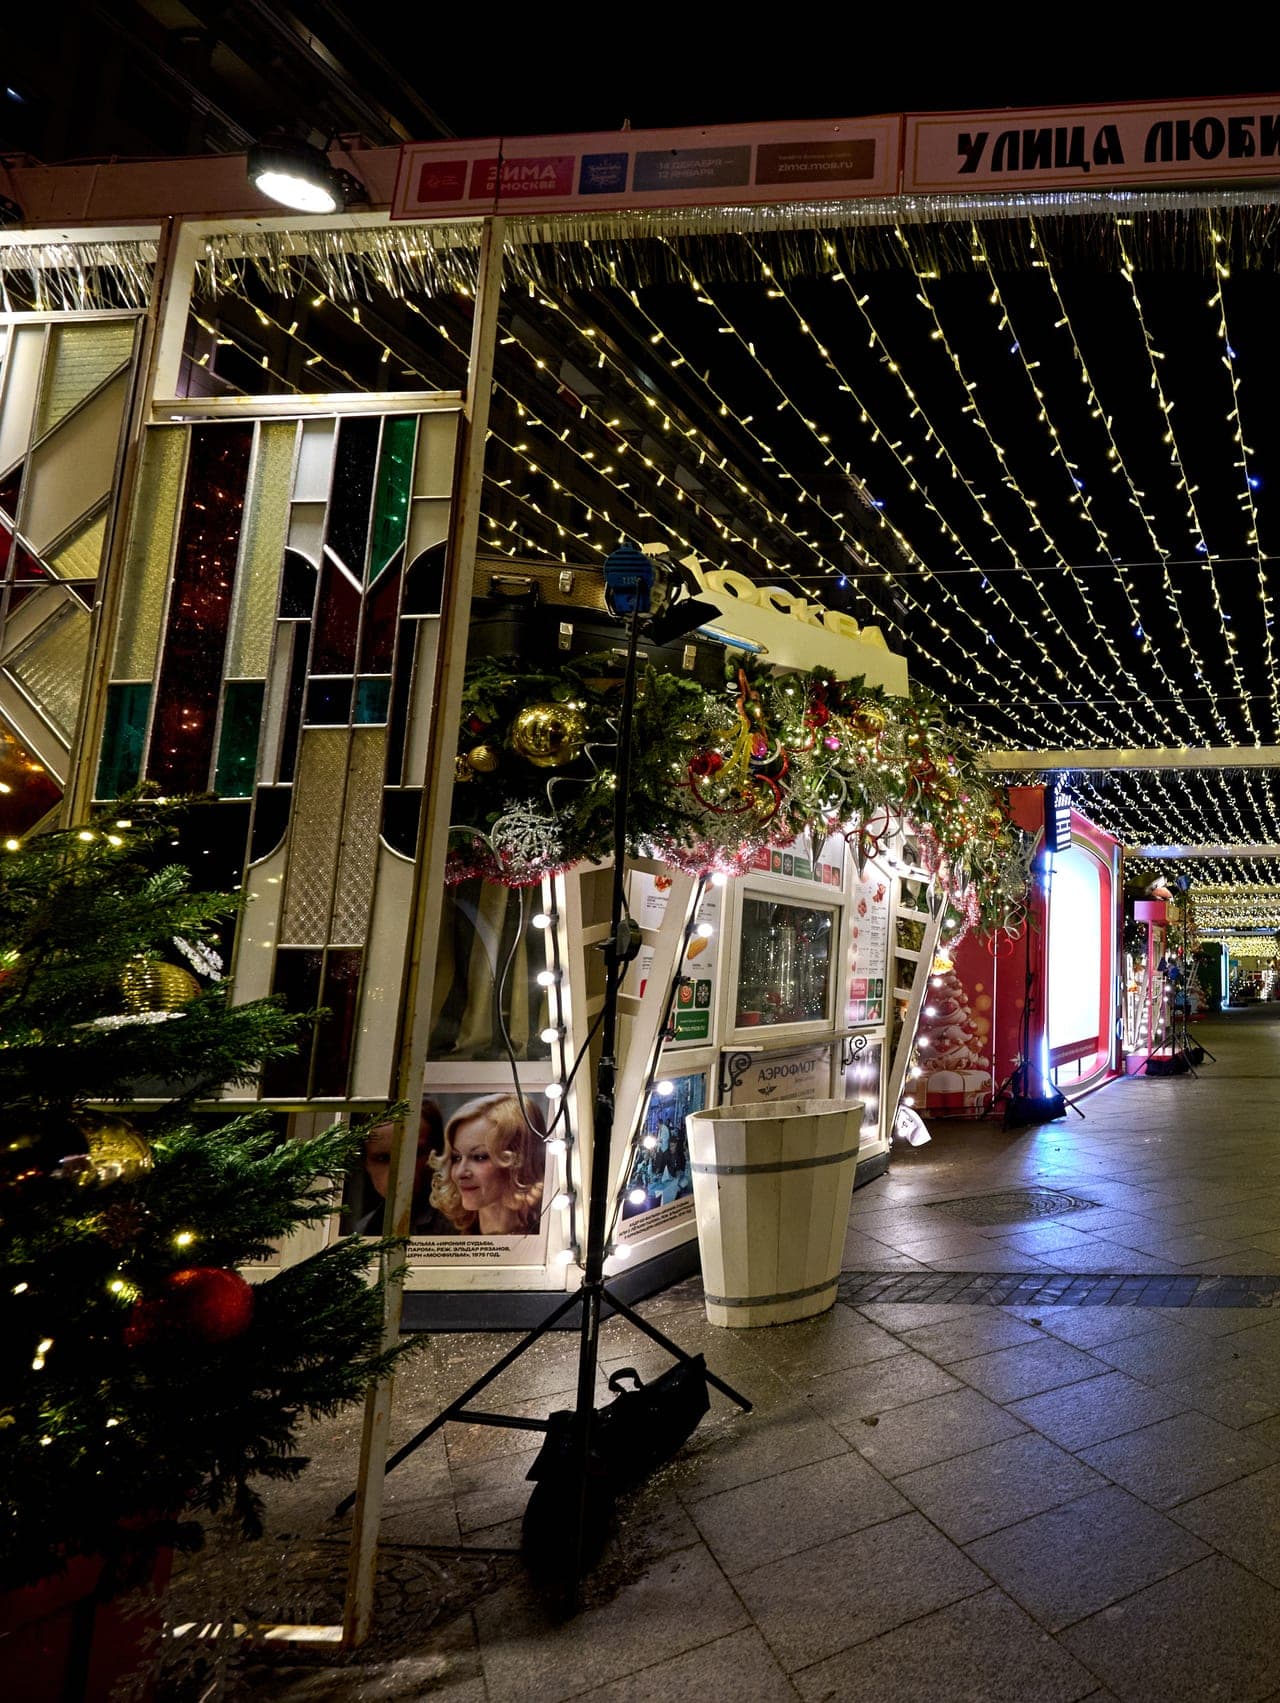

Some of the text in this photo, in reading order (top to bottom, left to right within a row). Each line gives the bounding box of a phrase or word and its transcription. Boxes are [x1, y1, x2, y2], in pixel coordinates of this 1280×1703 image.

[957, 125, 1125, 174] УЛИЦА
[487, 161, 557, 182] ЗИМА
[757, 1060, 817, 1083] АЭРОФЛОТ
